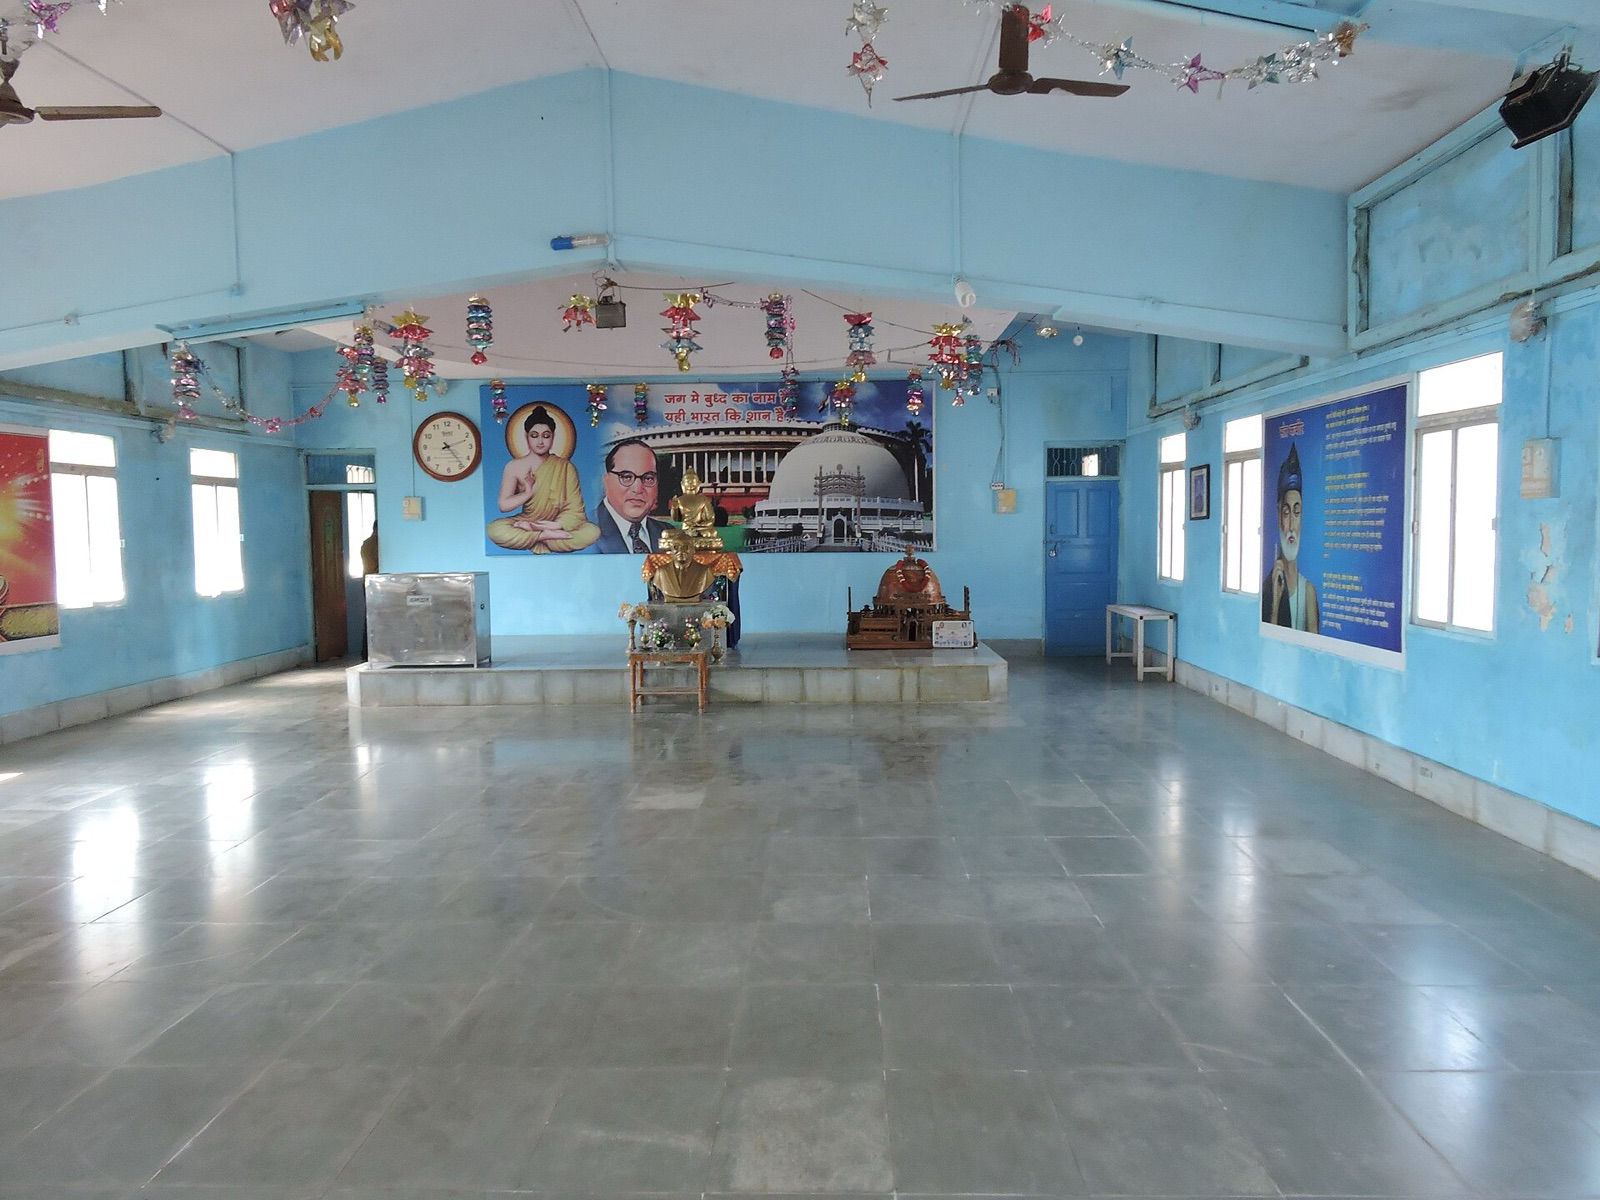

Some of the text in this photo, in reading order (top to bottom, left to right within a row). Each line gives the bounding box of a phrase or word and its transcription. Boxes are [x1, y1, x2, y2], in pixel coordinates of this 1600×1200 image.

[664, 394, 686, 404] जग
[690, 390, 700, 404] मे
[704, 393, 727, 407] बुध्द
[731, 394, 748, 404] का
[753, 394, 776, 404] नाम
[664, 407, 784, 423] यही भारत कि शान है
